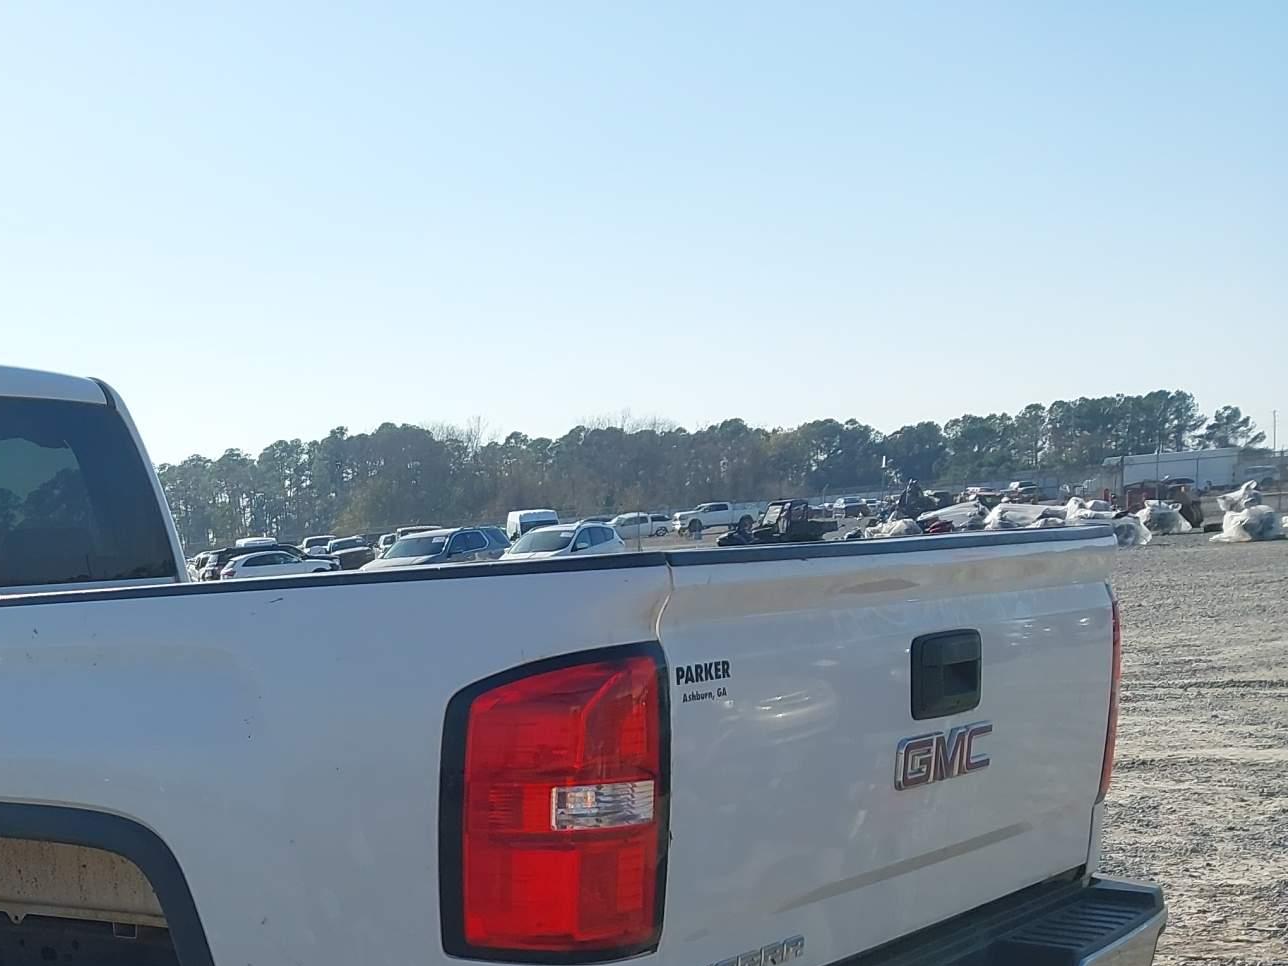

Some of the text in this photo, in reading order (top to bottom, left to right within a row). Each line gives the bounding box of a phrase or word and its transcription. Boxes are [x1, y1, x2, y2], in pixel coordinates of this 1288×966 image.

[675, 660, 731, 686] PARKER
[682, 687, 728, 703] Ashburn, GA
[894, 720, 993, 791] GMC
